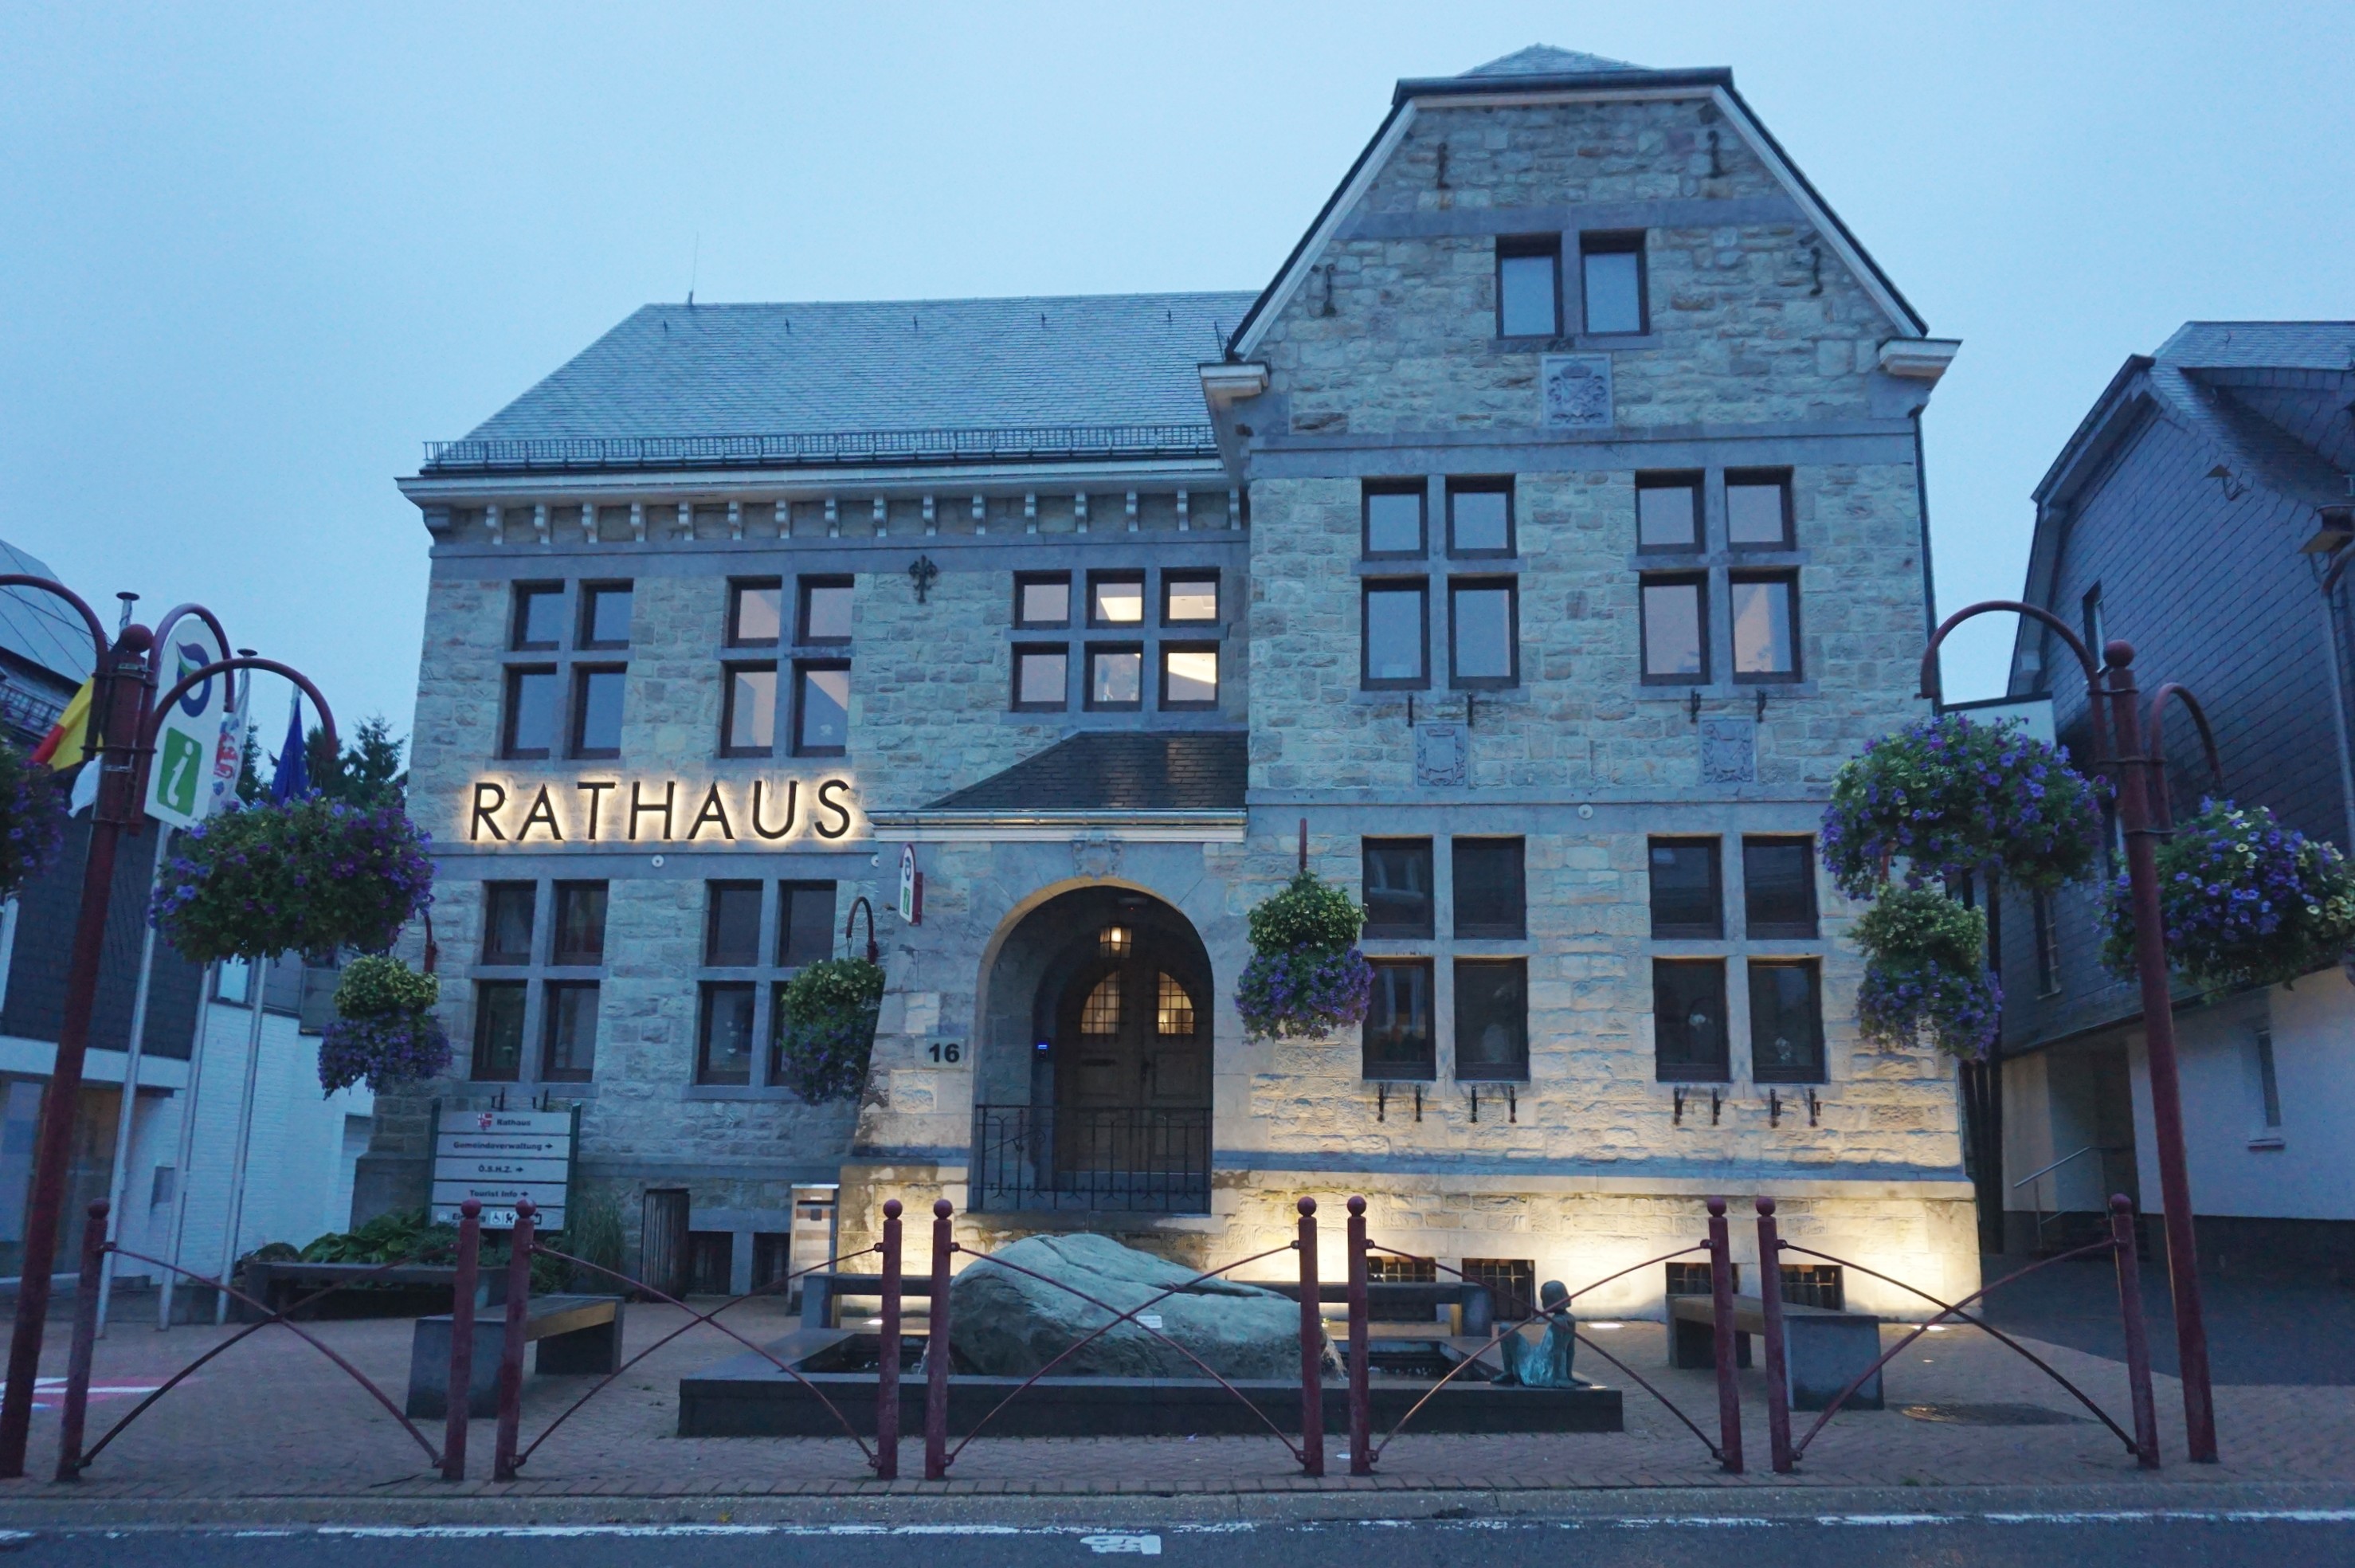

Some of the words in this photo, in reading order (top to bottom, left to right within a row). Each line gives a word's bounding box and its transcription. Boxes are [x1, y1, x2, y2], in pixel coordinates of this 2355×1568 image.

[470, 779, 851, 841] RATHAUS
[928, 1042, 960, 1063] 16
[453, 1142, 543, 1151] Gemeindeverwaltung
